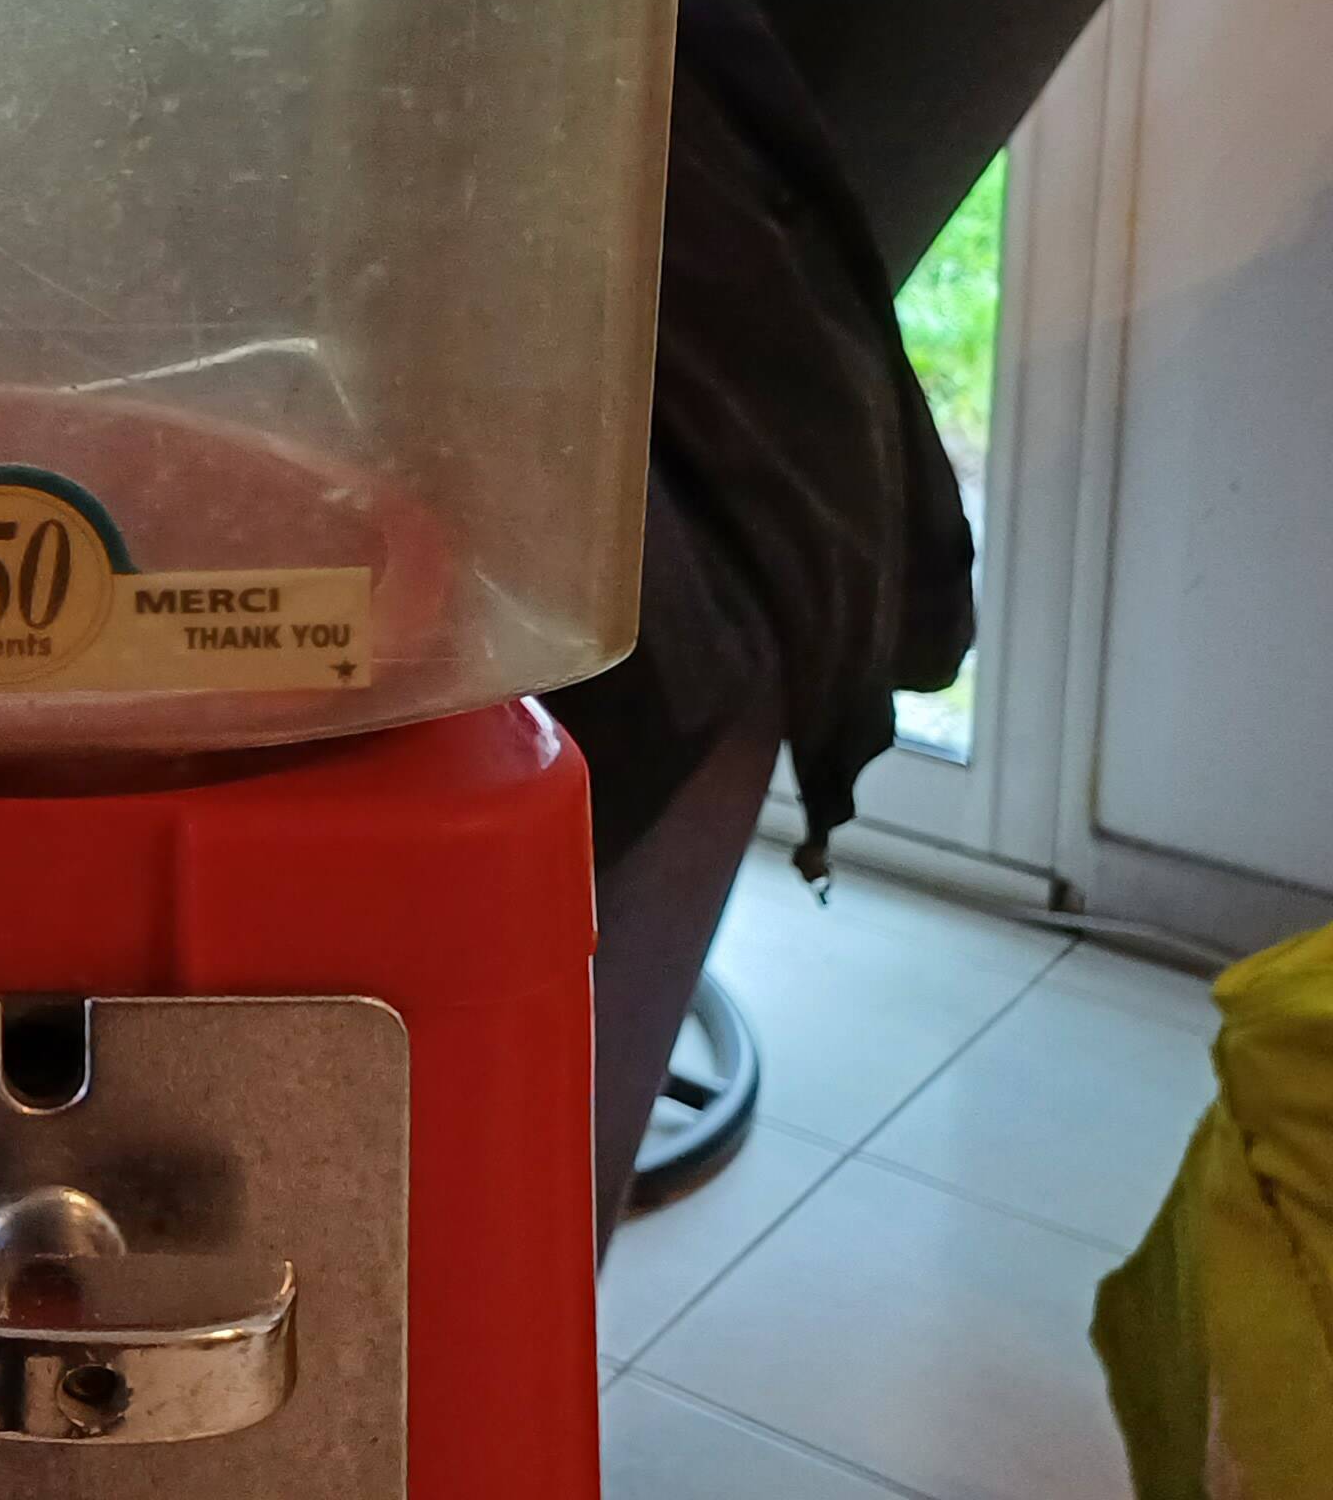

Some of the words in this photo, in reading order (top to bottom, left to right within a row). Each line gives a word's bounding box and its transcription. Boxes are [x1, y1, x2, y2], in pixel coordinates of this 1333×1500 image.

[134, 587, 281, 616] MERCI
[185, 625, 282, 652] THANK
[292, 622, 352, 649] YOU
